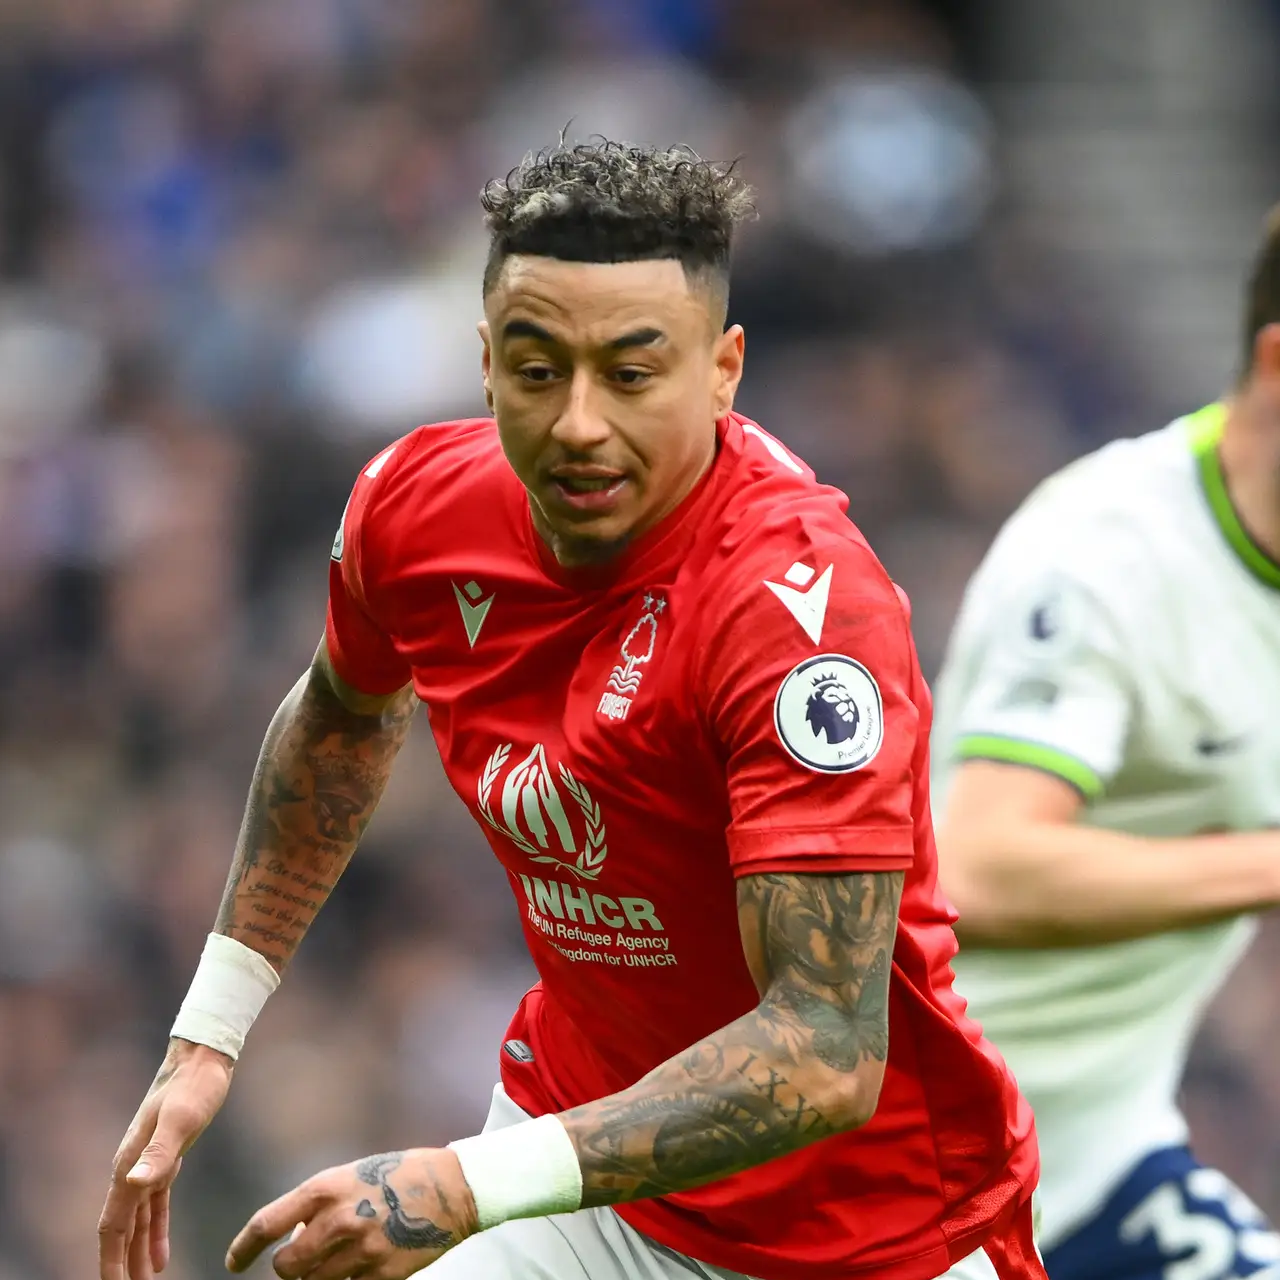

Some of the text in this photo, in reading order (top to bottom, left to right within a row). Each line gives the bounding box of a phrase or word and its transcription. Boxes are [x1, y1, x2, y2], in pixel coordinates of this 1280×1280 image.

[838, 706, 873, 760] Premier League
[528, 903, 669, 950] The UN Refugee Agency
[605, 952, 621, 965] for
[625, 954, 677, 967] UNHCR
